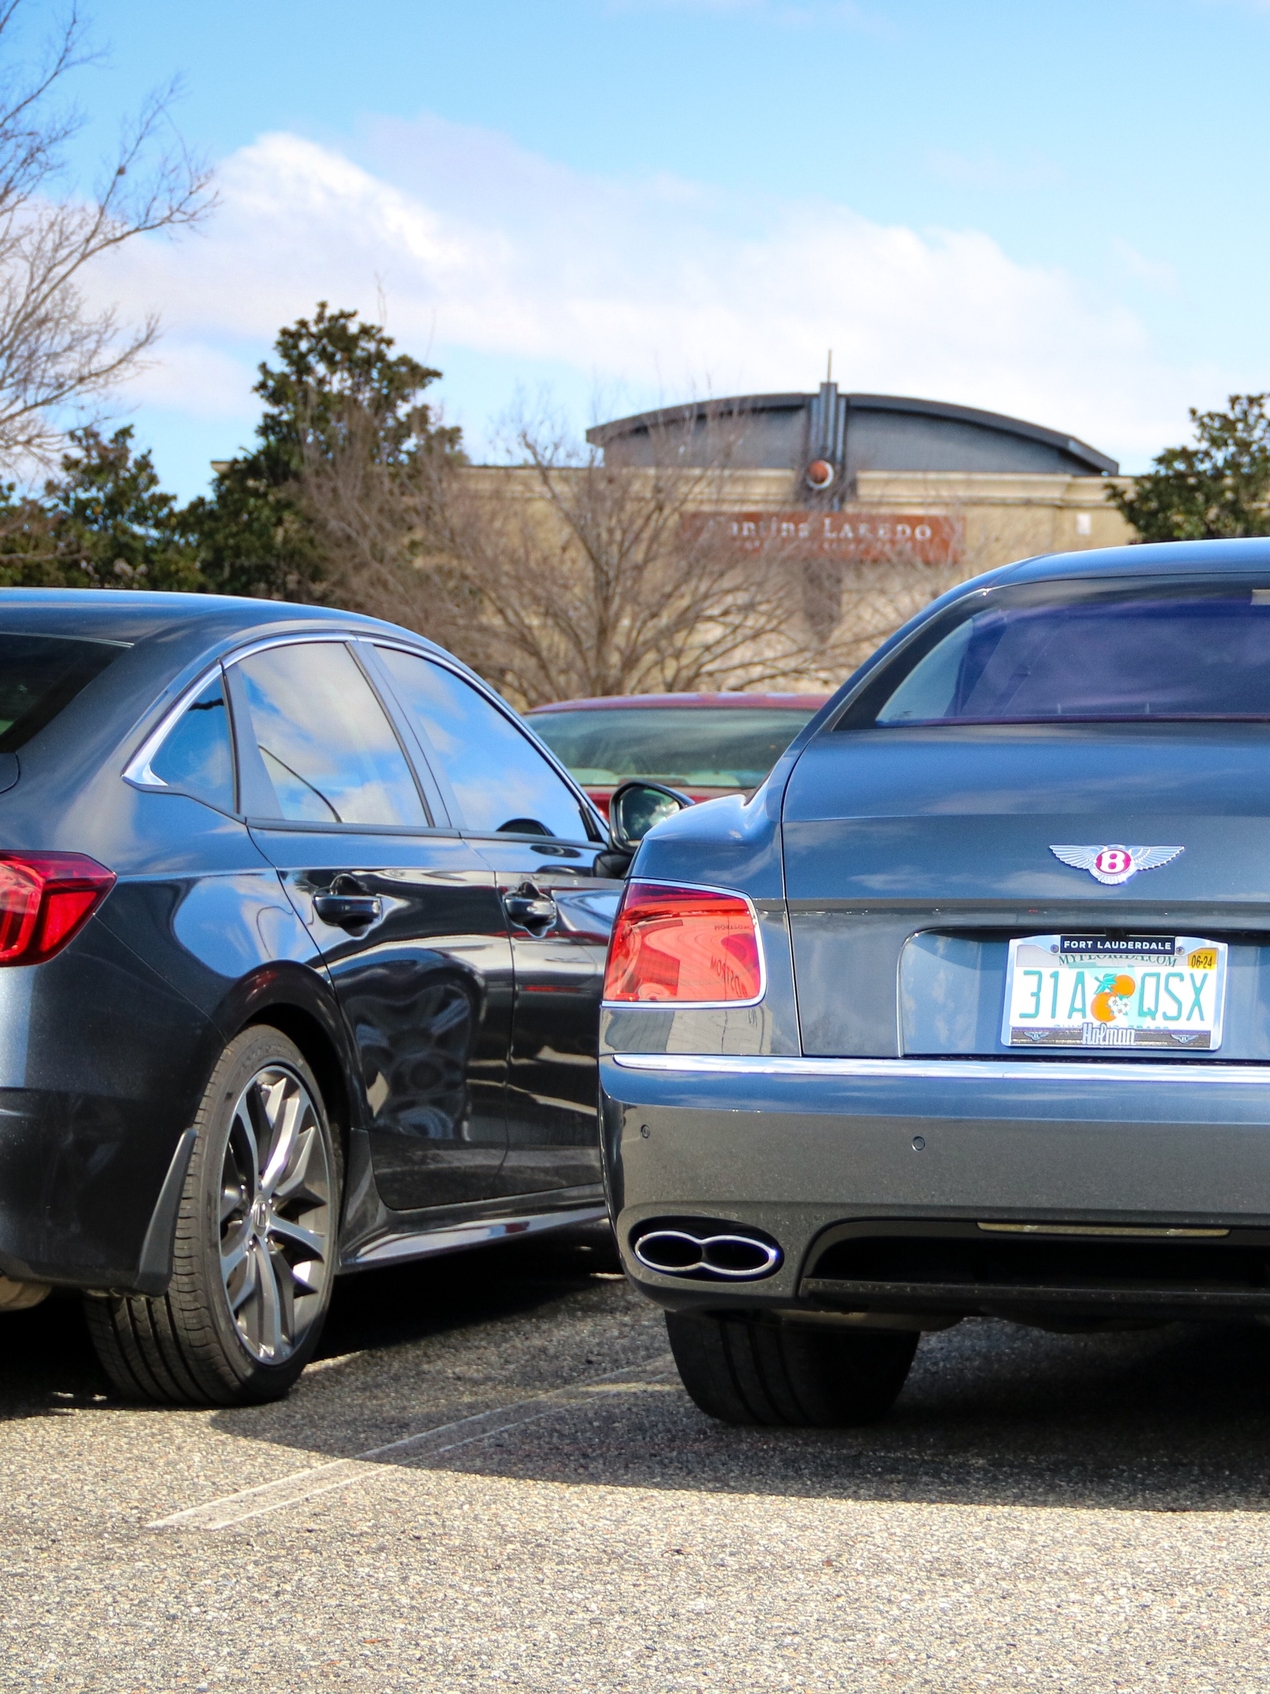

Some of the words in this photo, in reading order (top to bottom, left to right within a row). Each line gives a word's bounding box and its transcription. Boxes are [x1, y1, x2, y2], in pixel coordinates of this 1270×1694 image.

[709, 515, 810, 539] antina
[1063, 940, 1094, 950] FORT
[1097, 940, 1172, 951] LAUDERDALE
[1191, 954, 1213, 969] 06-24
[1081, 1022, 1137, 1046] Holman
